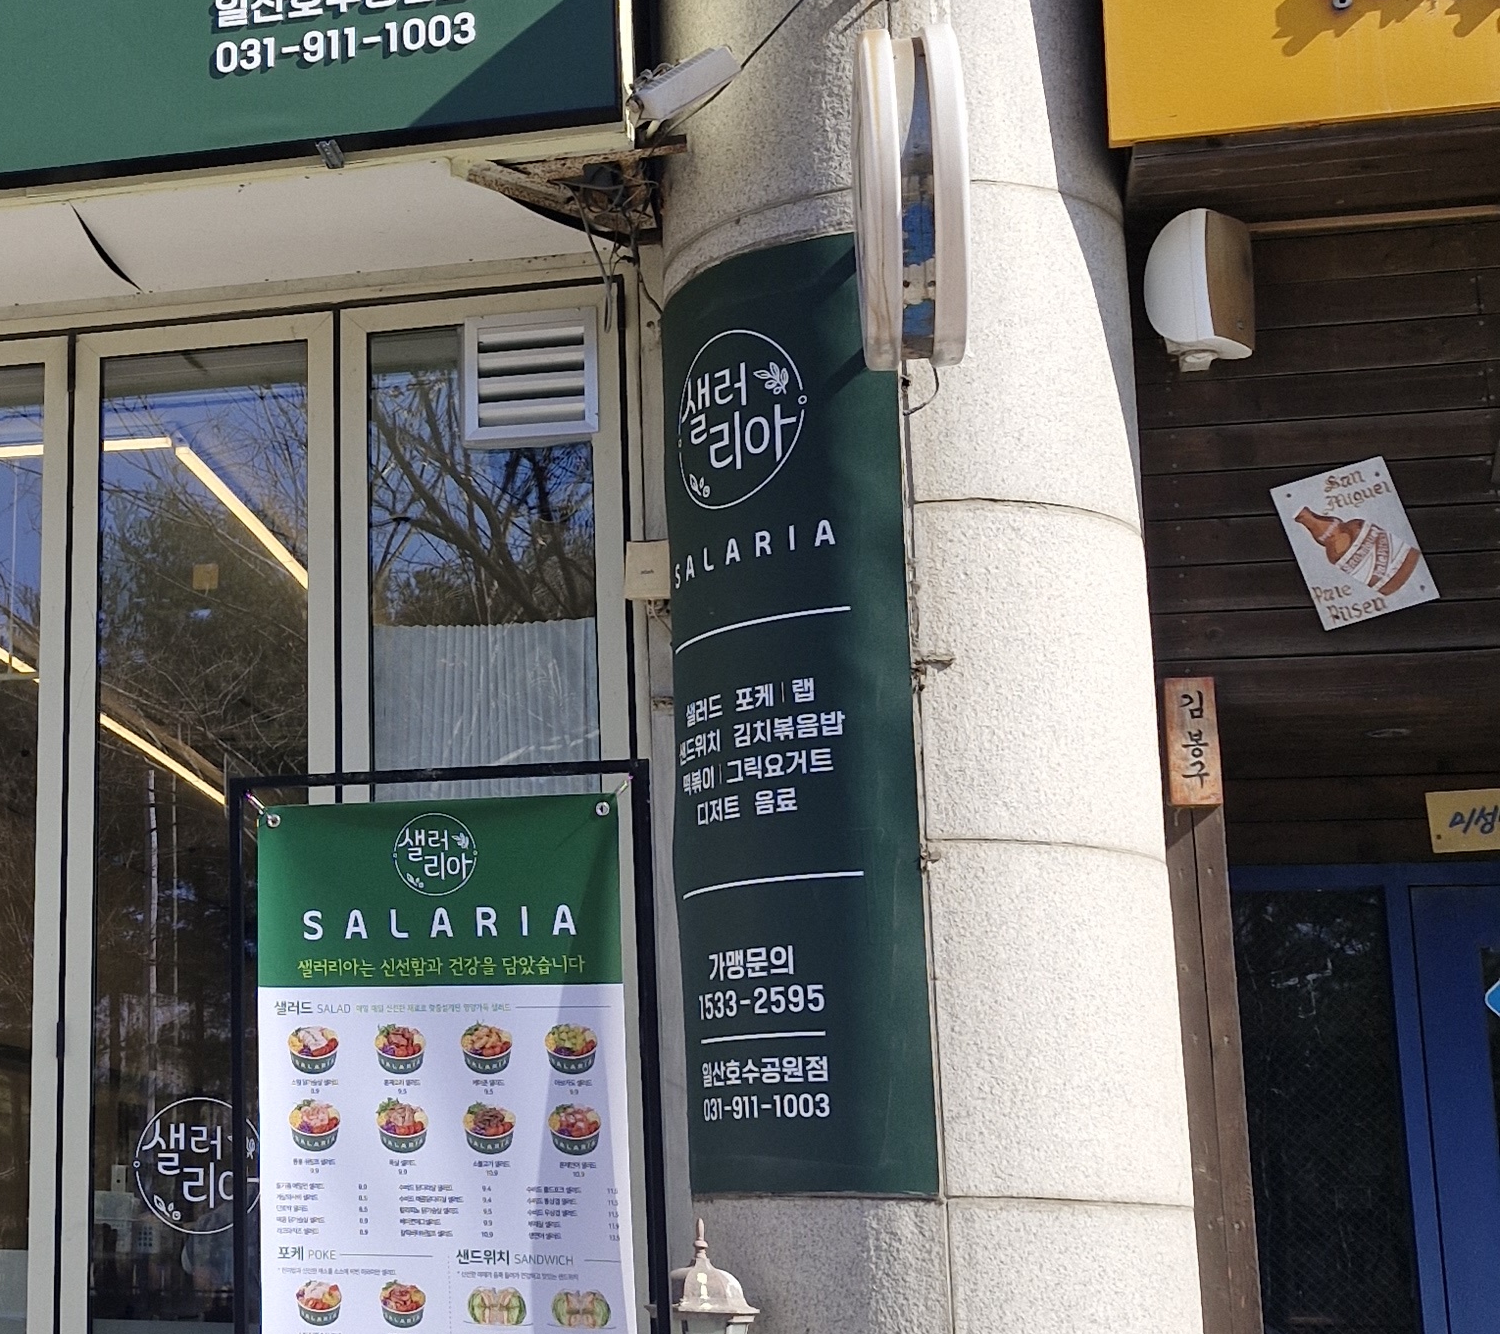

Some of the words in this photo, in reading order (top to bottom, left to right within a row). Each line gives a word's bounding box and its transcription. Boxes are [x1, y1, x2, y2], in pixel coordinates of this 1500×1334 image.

[214, 12, 476, 74] 031-911-1003
[681, 362, 747, 445] 샐러
[708, 403, 798, 470] 리아
[1324, 470, 1366, 494] San
[674, 519, 836, 589] SALARIA
[685, 694, 723, 728] 샐러드
[735, 683, 774, 712] 포케
[791, 677, 816, 704] 랩
[678, 728, 721, 767] 샌드위치
[733, 710, 846, 748] 김치볶음밥
[682, 765, 715, 797] 떡볶이
[726, 747, 834, 784] 그릭요거트
[696, 795, 741, 826] 디저트
[754, 787, 798, 816] 음료
[398, 827, 449, 861] 샐러
[424, 852, 473, 881] 리아
[302, 904, 578, 942] SALARIA
[298, 957, 376, 978] 샐러리아는
[380, 957, 443, 977] 신선함과
[449, 956, 498, 976] 건강을
[501, 954, 586, 976] 담았습니다
[708, 944, 795, 982] 가맹문의
[274, 1000, 314, 1016] 샐러드
[317, 1003, 351, 1014] SALAD
[698, 984, 826, 1021] 1533-2595
[701, 1055, 829, 1089] 일산호수공원점
[703, 1092, 831, 1122] 031-911-1003
[141, 1118, 222, 1176] 샐러
[277, 1246, 304, 1261] 포케
[308, 1249, 337, 1260] POKE
[455, 1249, 510, 1266] 샌드위치
[513, 1253, 575, 1266] SANDWICH
